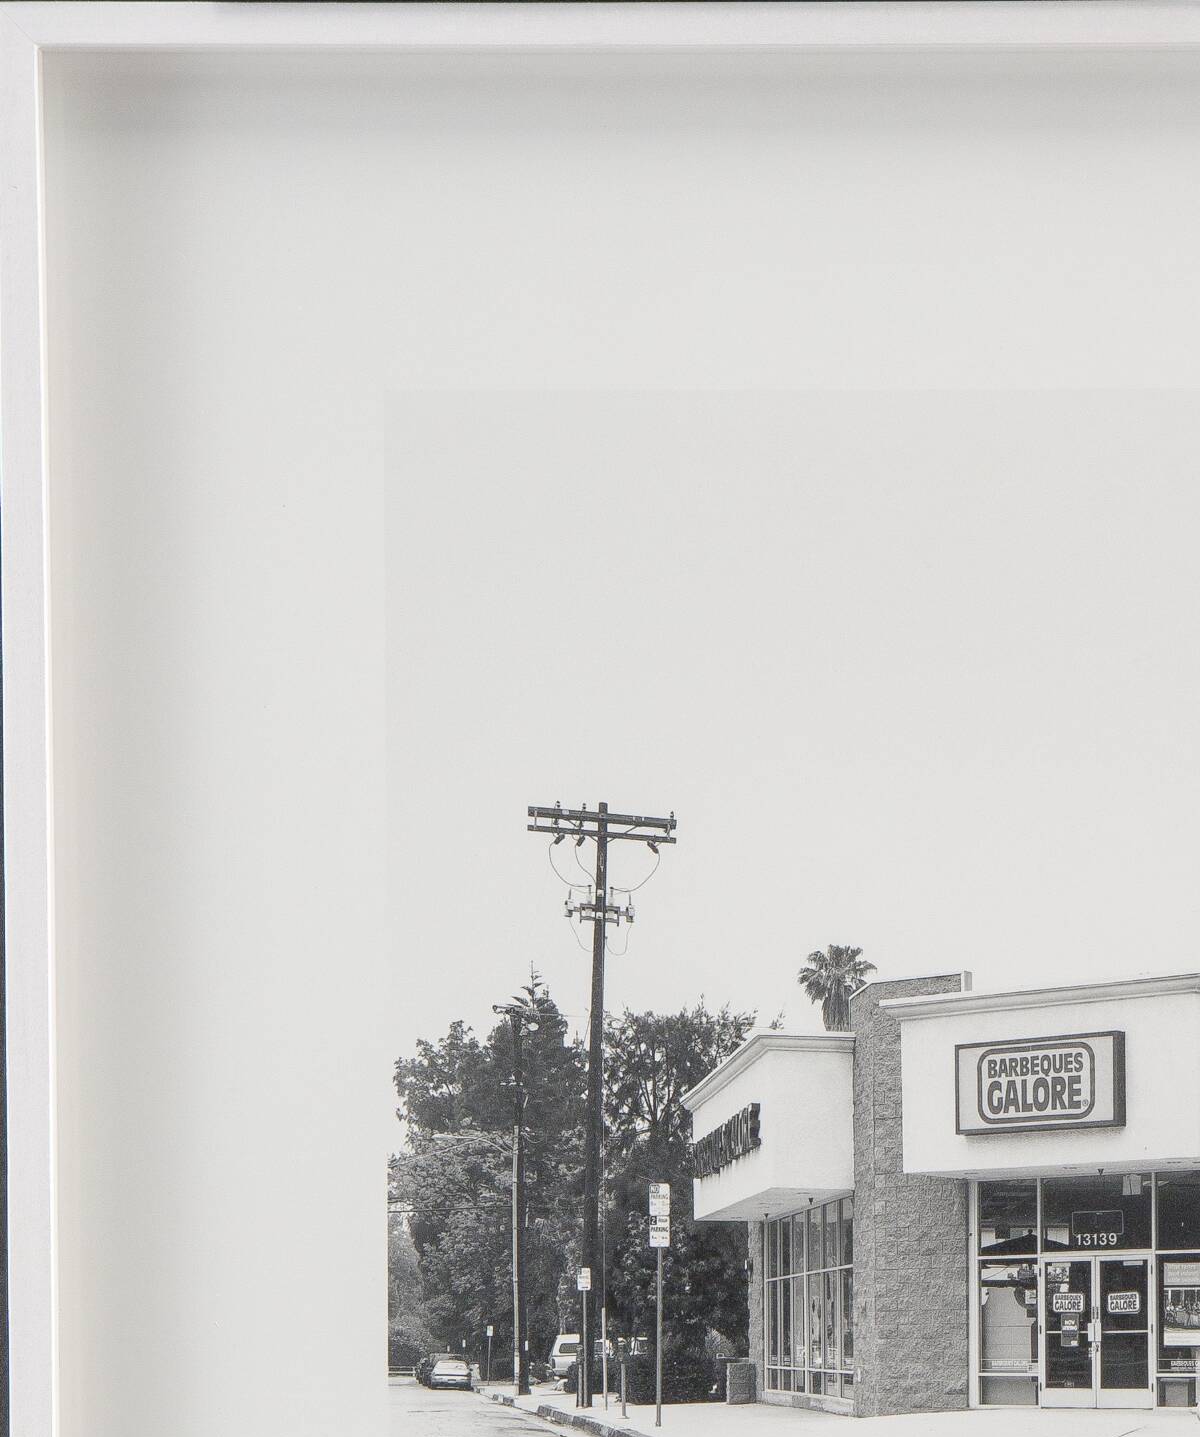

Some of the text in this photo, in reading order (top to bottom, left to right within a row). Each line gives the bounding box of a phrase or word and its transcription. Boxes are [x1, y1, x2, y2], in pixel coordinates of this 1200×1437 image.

[987, 1052, 1084, 1079] BARBEQUES
[987, 1075, 1082, 1115] GALORE
[1075, 1233, 1117, 1246] 13139
[1109, 1293, 1137, 1301] BARBEQUES
[1054, 1300, 1081, 1311] GALORE
[1109, 1300, 1137, 1311] GALORE
